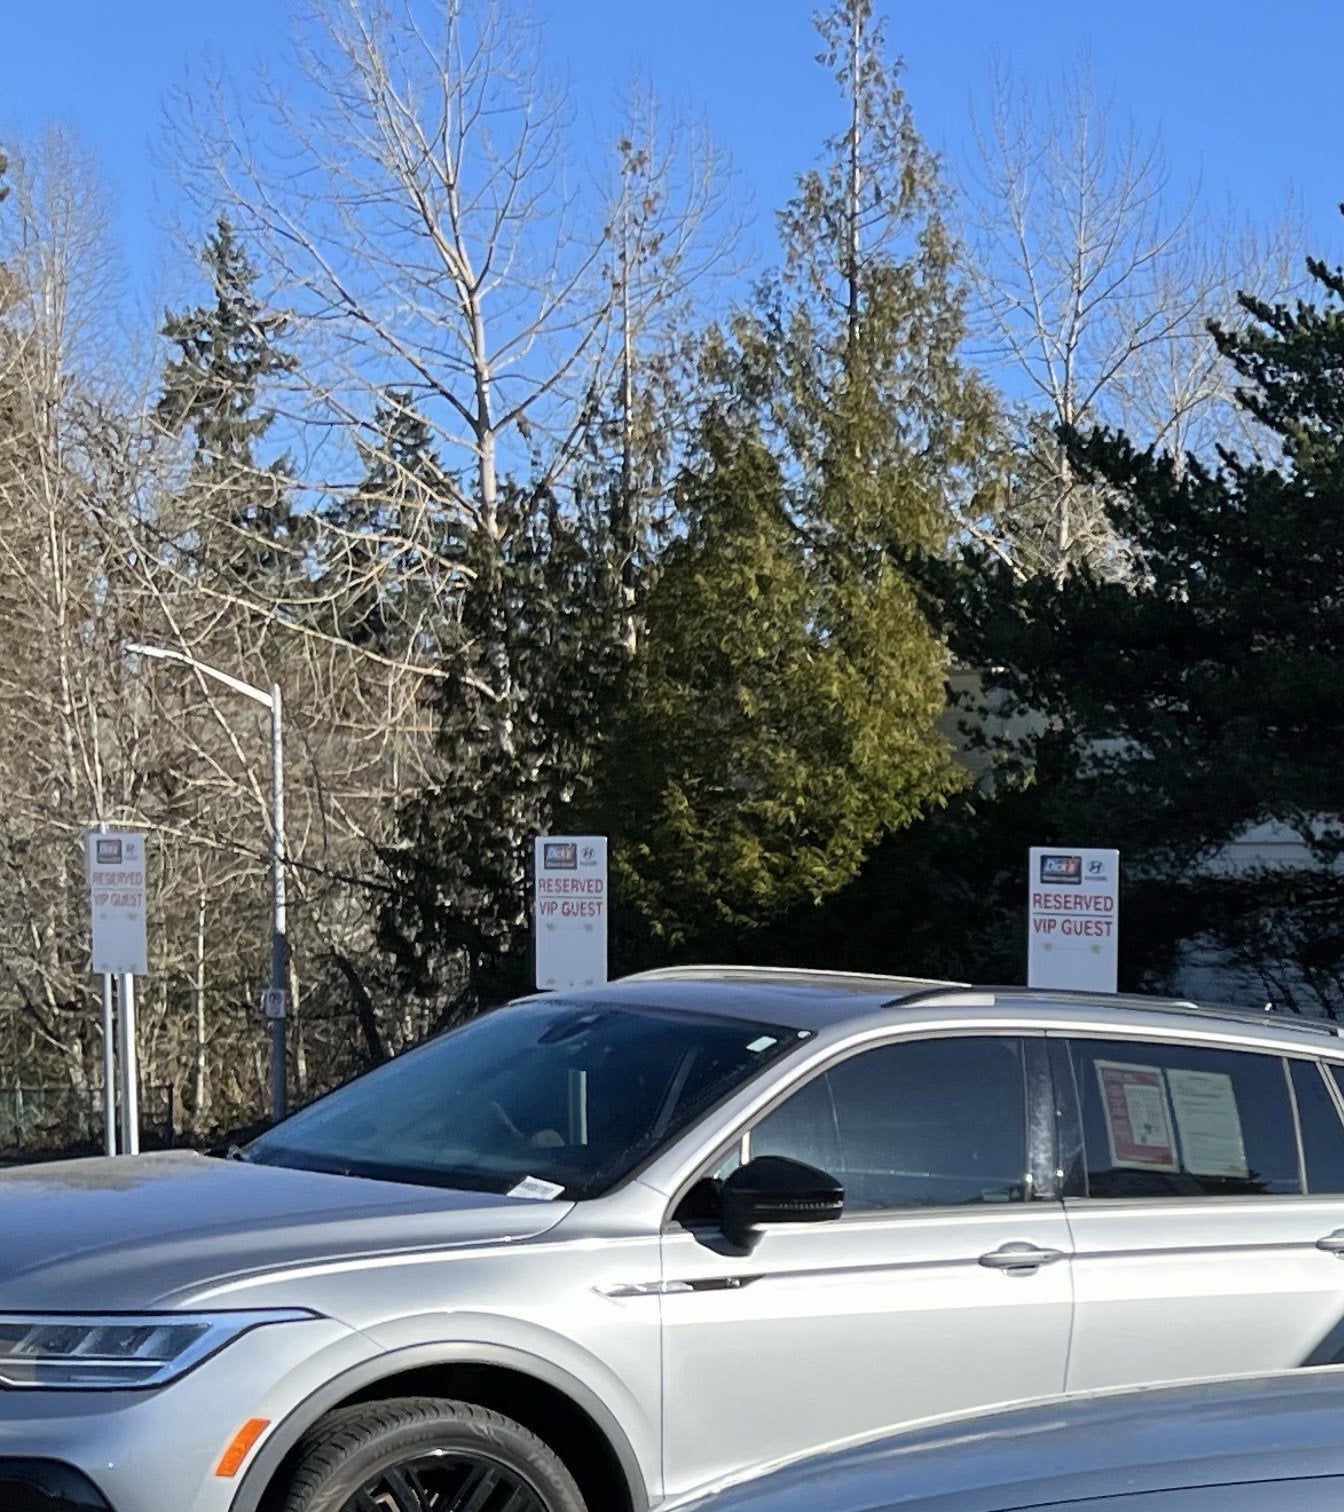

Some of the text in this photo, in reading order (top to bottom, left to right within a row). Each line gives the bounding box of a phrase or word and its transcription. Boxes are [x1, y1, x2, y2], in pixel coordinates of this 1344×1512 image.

[538, 878, 604, 893] RESERVED
[539, 901, 603, 917] VIP GUEST
[1032, 893, 1114, 912] RESERVED
[1033, 918, 1113, 937] VIP GUEST
